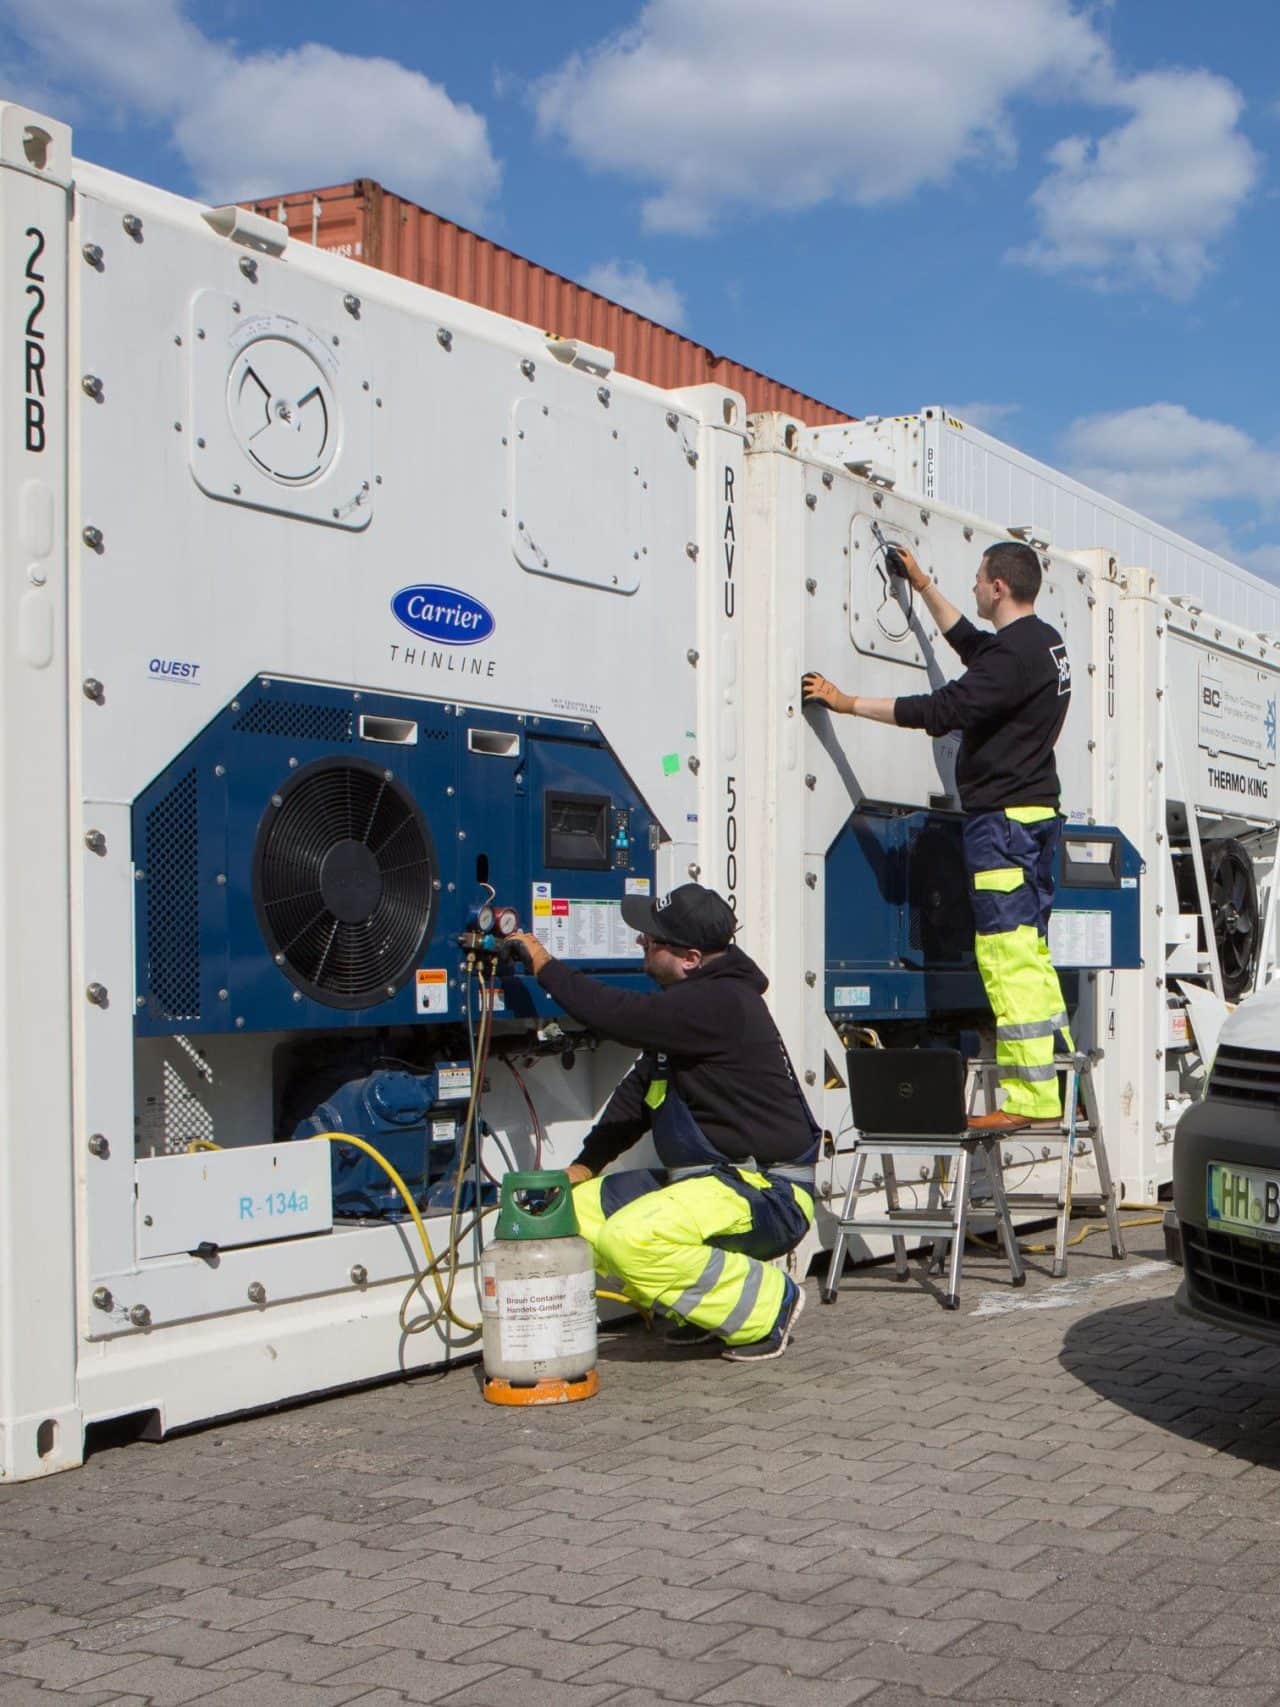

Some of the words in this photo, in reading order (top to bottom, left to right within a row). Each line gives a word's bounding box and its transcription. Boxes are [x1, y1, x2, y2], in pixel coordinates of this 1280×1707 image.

[25, 227, 45, 453] 22RB
[724, 465, 735, 618] RAVU
[407, 595, 483, 630] Carrier
[149, 658, 200, 678] QUEST
[390, 644, 497, 677] THINLINE
[1203, 687, 1221, 708] BC
[1208, 768, 1246, 794] THERMO
[1247, 775, 1268, 798] KING
[240, 1191, 309, 1220] R-134a
[1222, 1171, 1250, 1220] HH
[506, 1297, 528, 1305] Braun
[530, 1294, 567, 1304] Container
